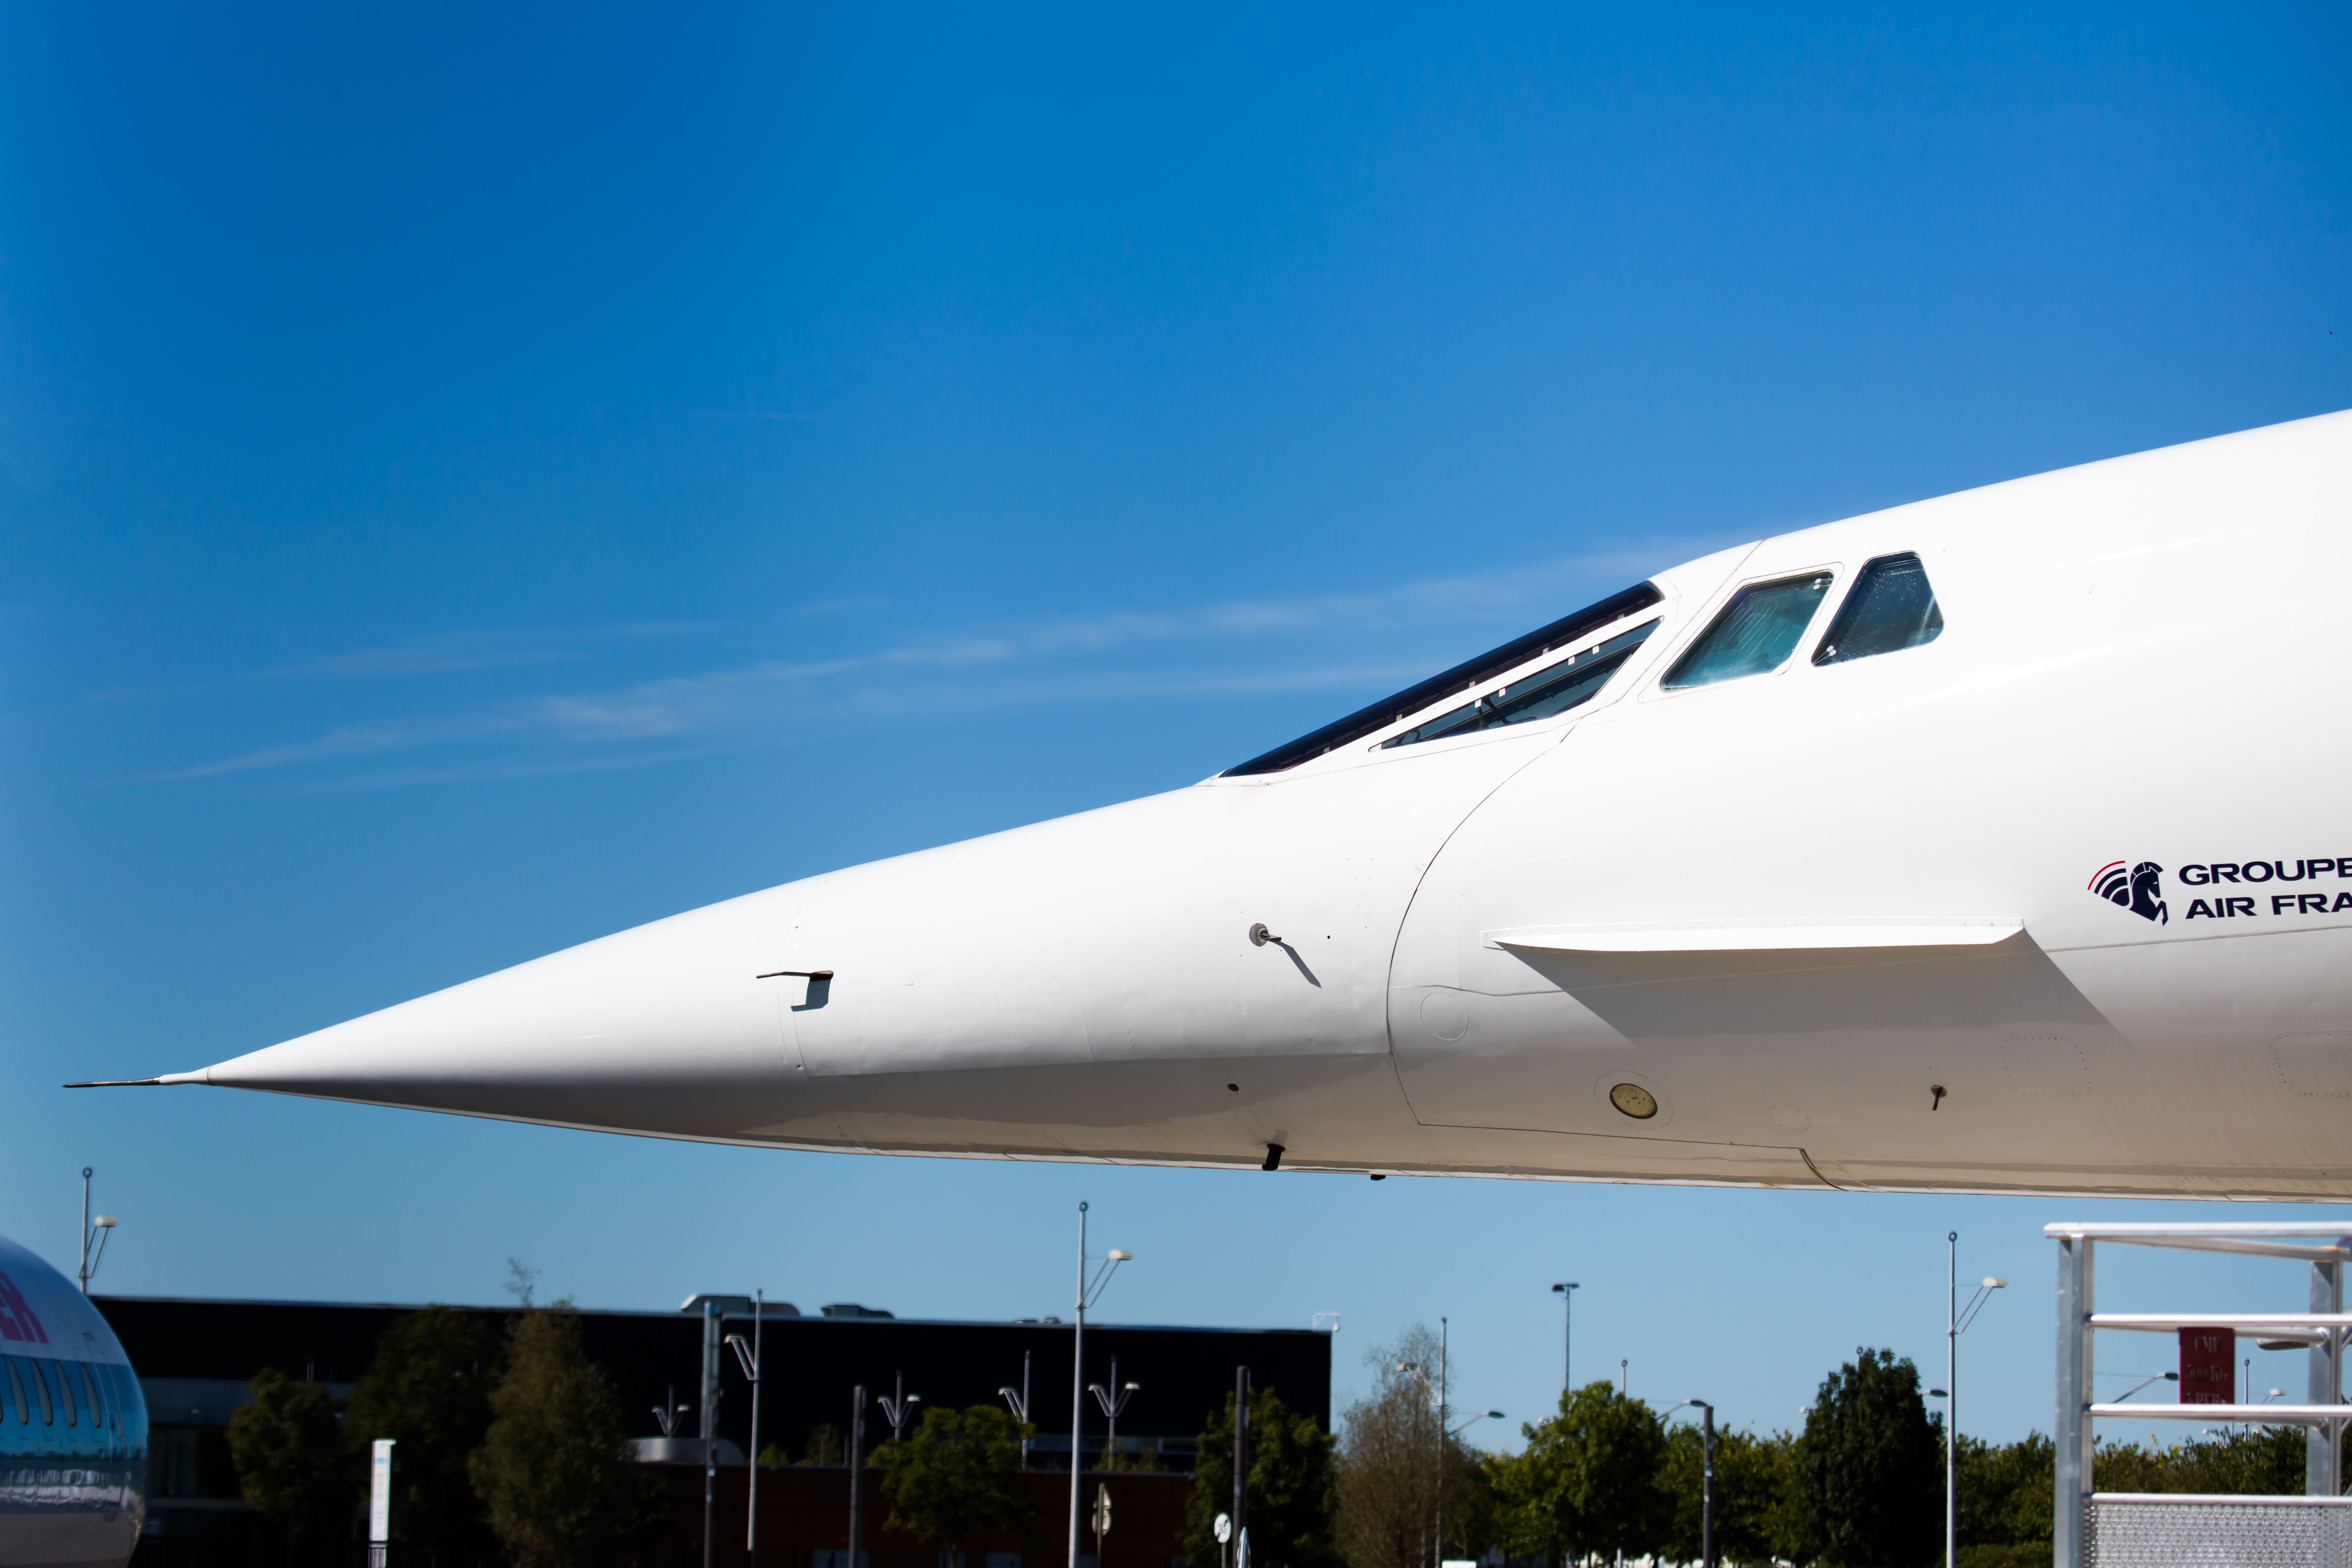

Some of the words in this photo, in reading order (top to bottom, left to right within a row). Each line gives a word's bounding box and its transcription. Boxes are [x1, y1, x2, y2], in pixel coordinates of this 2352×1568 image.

[2179, 857, 2352, 886] GROUPE
[2185, 897, 2257, 919] AIR
[2211, 1365, 2228, 1381] KG
